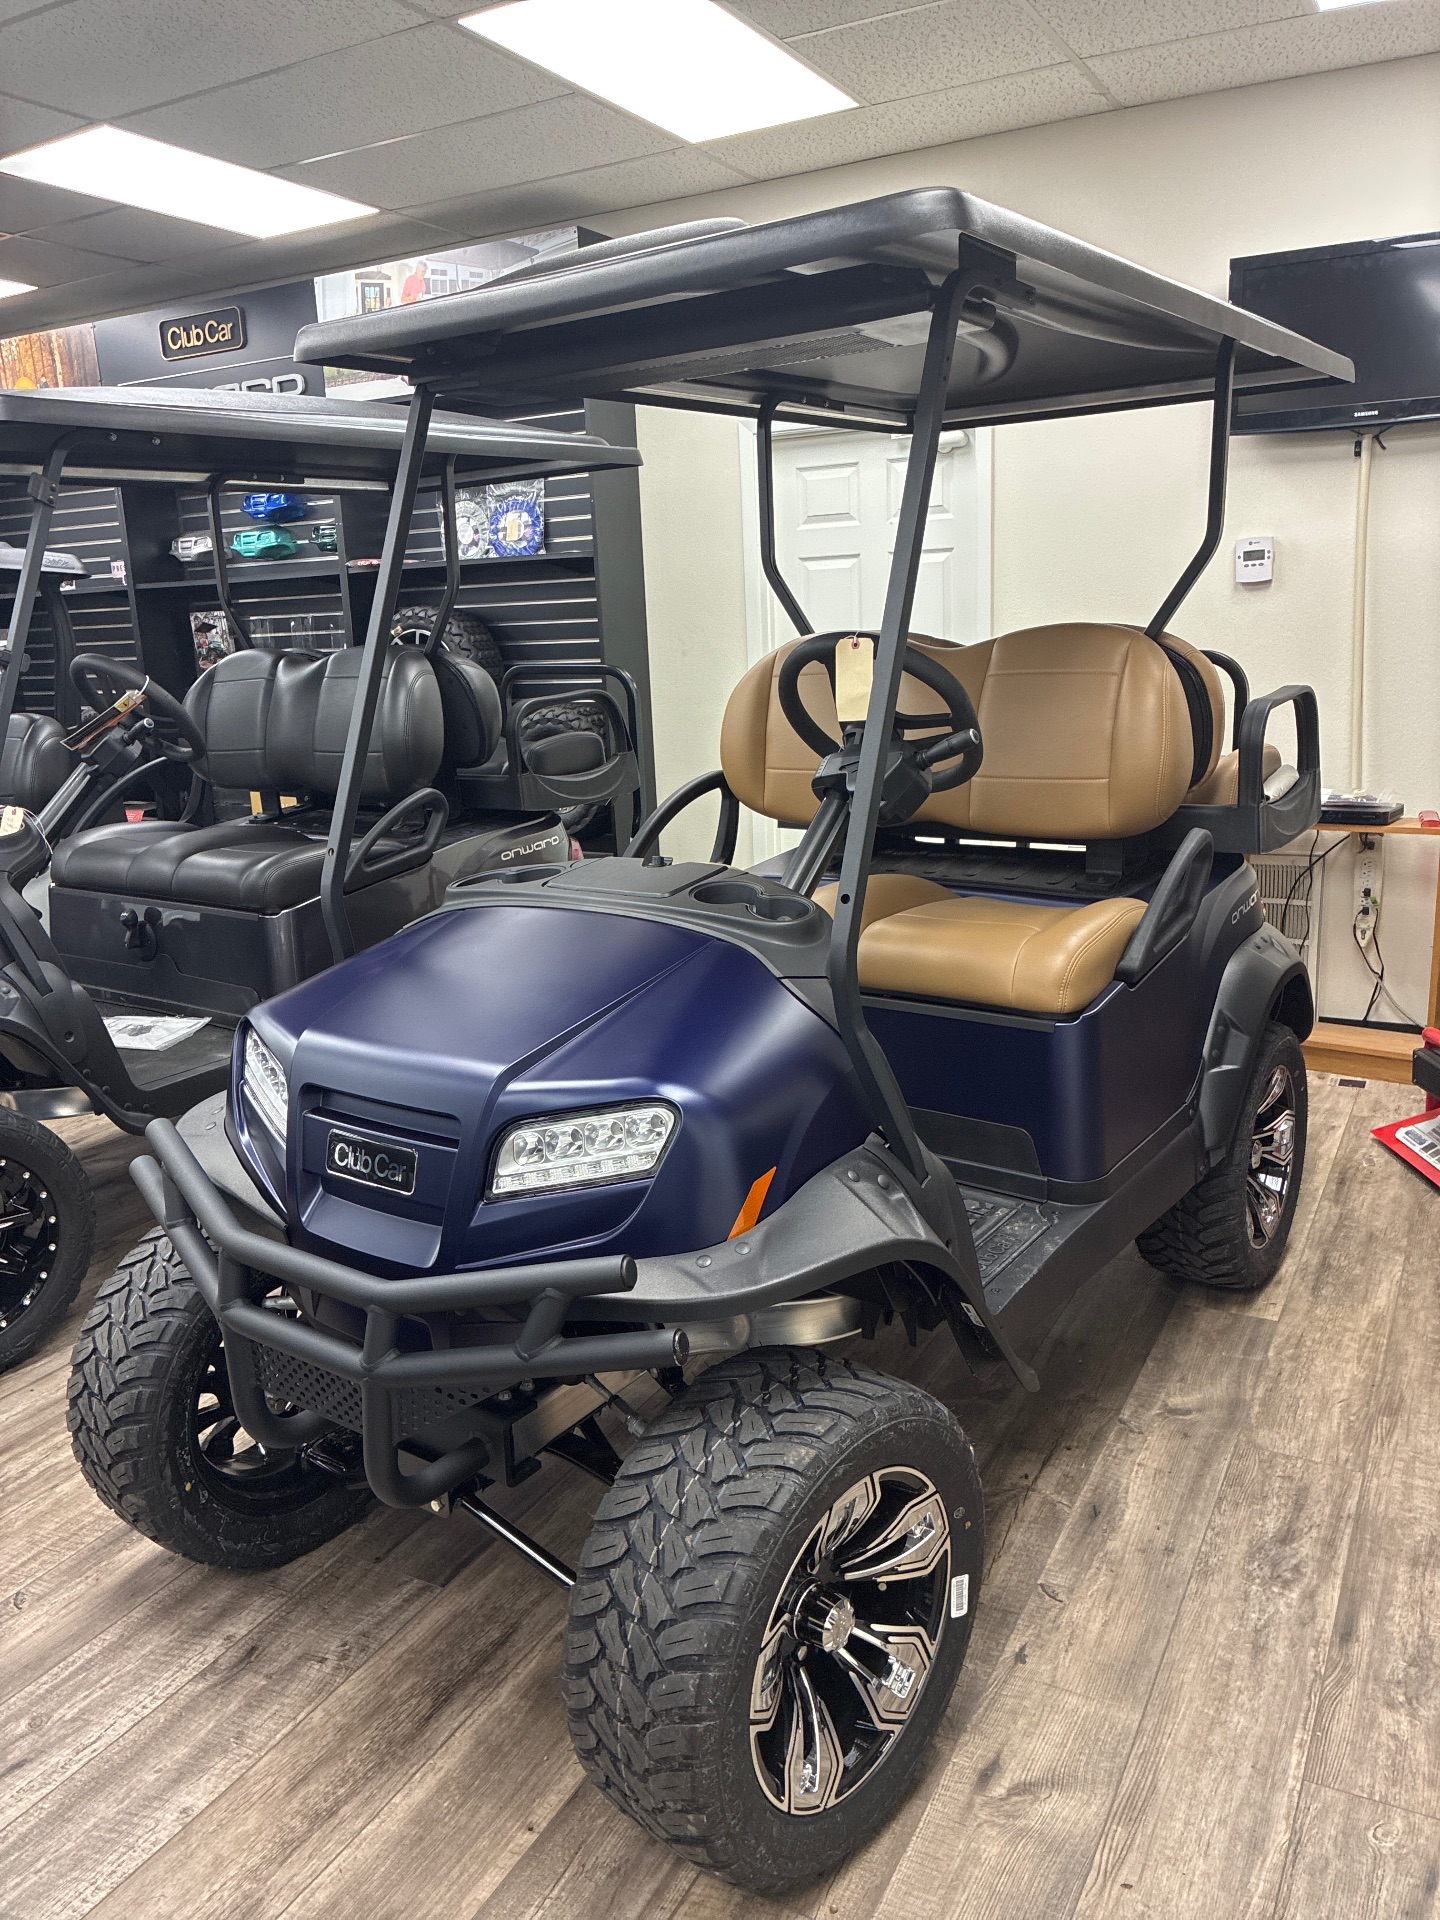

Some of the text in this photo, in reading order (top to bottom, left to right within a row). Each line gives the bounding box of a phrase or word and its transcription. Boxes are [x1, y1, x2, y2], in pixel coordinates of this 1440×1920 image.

[167, 320, 233, 350] Club Car
[334, 1142, 407, 1183] Club Car
